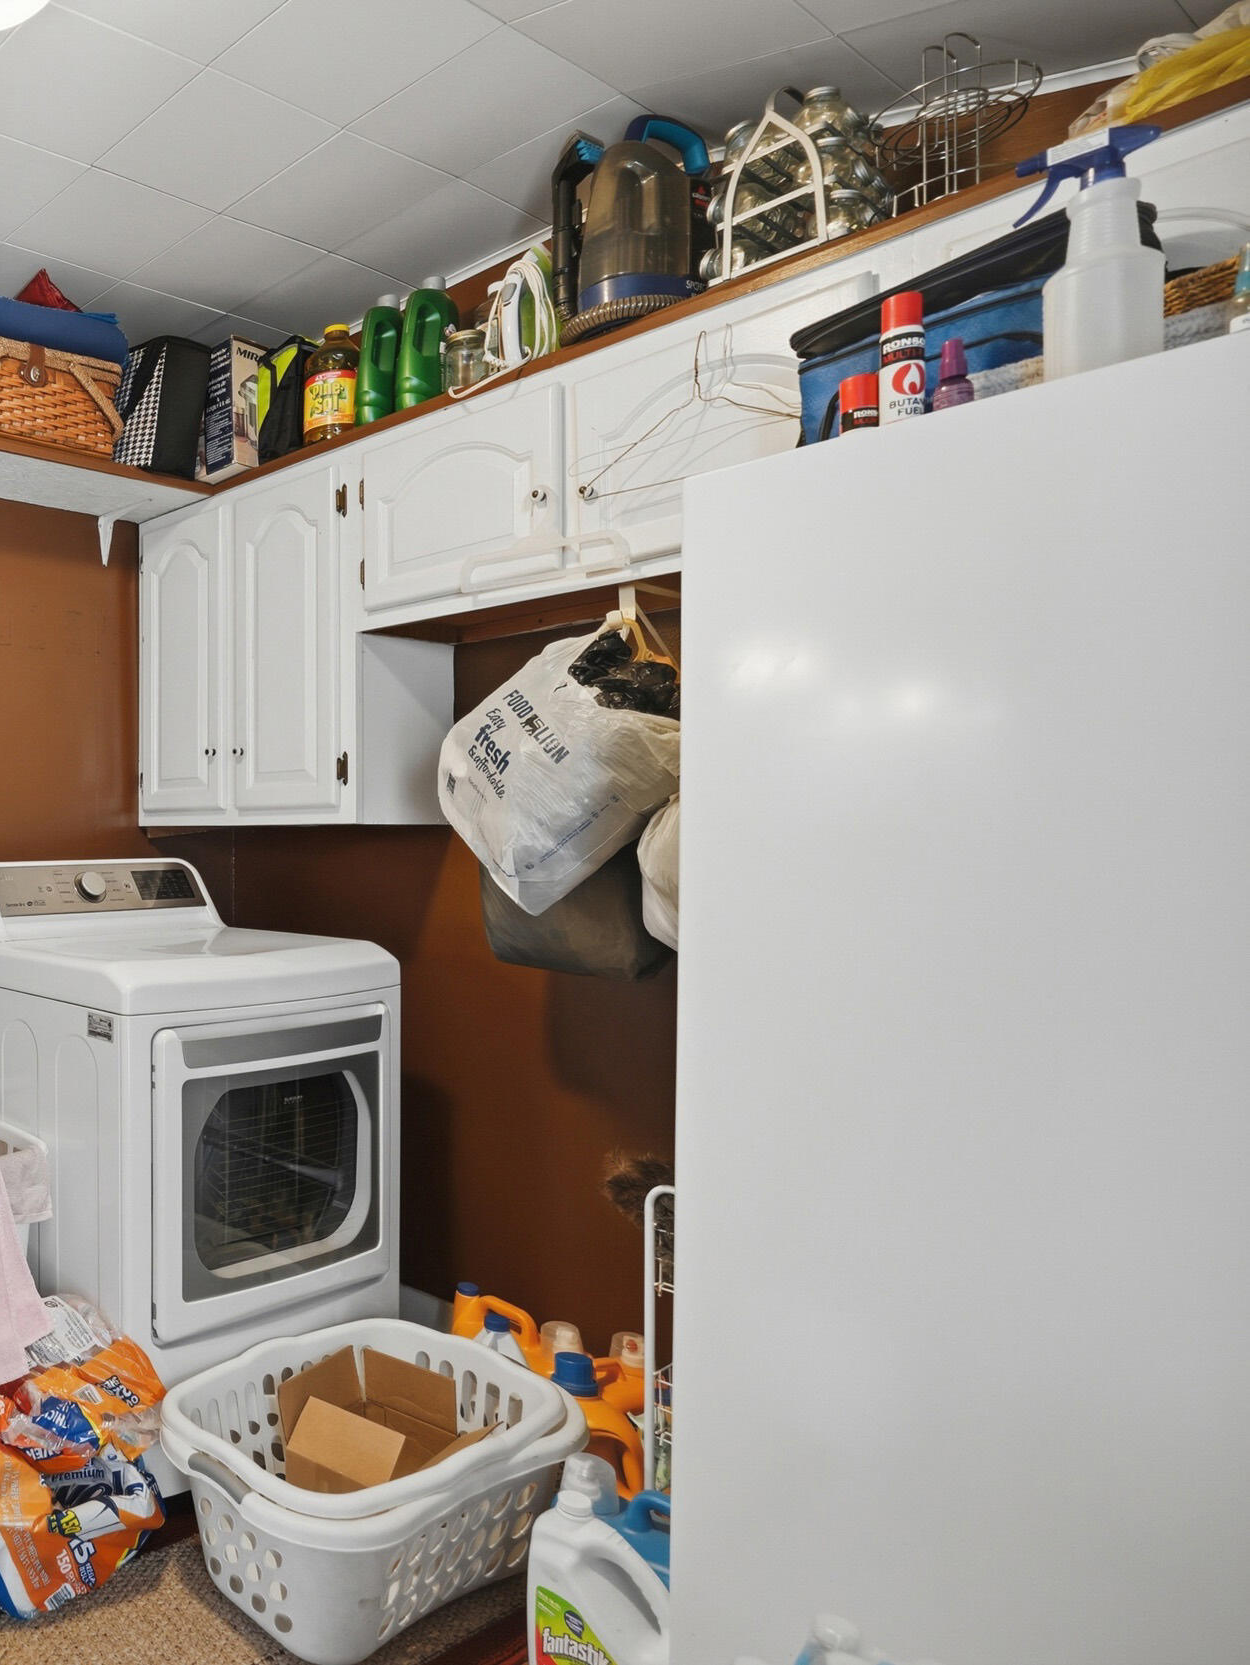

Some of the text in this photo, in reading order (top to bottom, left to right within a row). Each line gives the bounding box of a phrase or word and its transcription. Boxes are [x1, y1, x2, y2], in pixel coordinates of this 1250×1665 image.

[485, 708, 507, 735] Easy
[502, 689, 570, 765] FOOD LION
[475, 723, 512, 776] fresh
